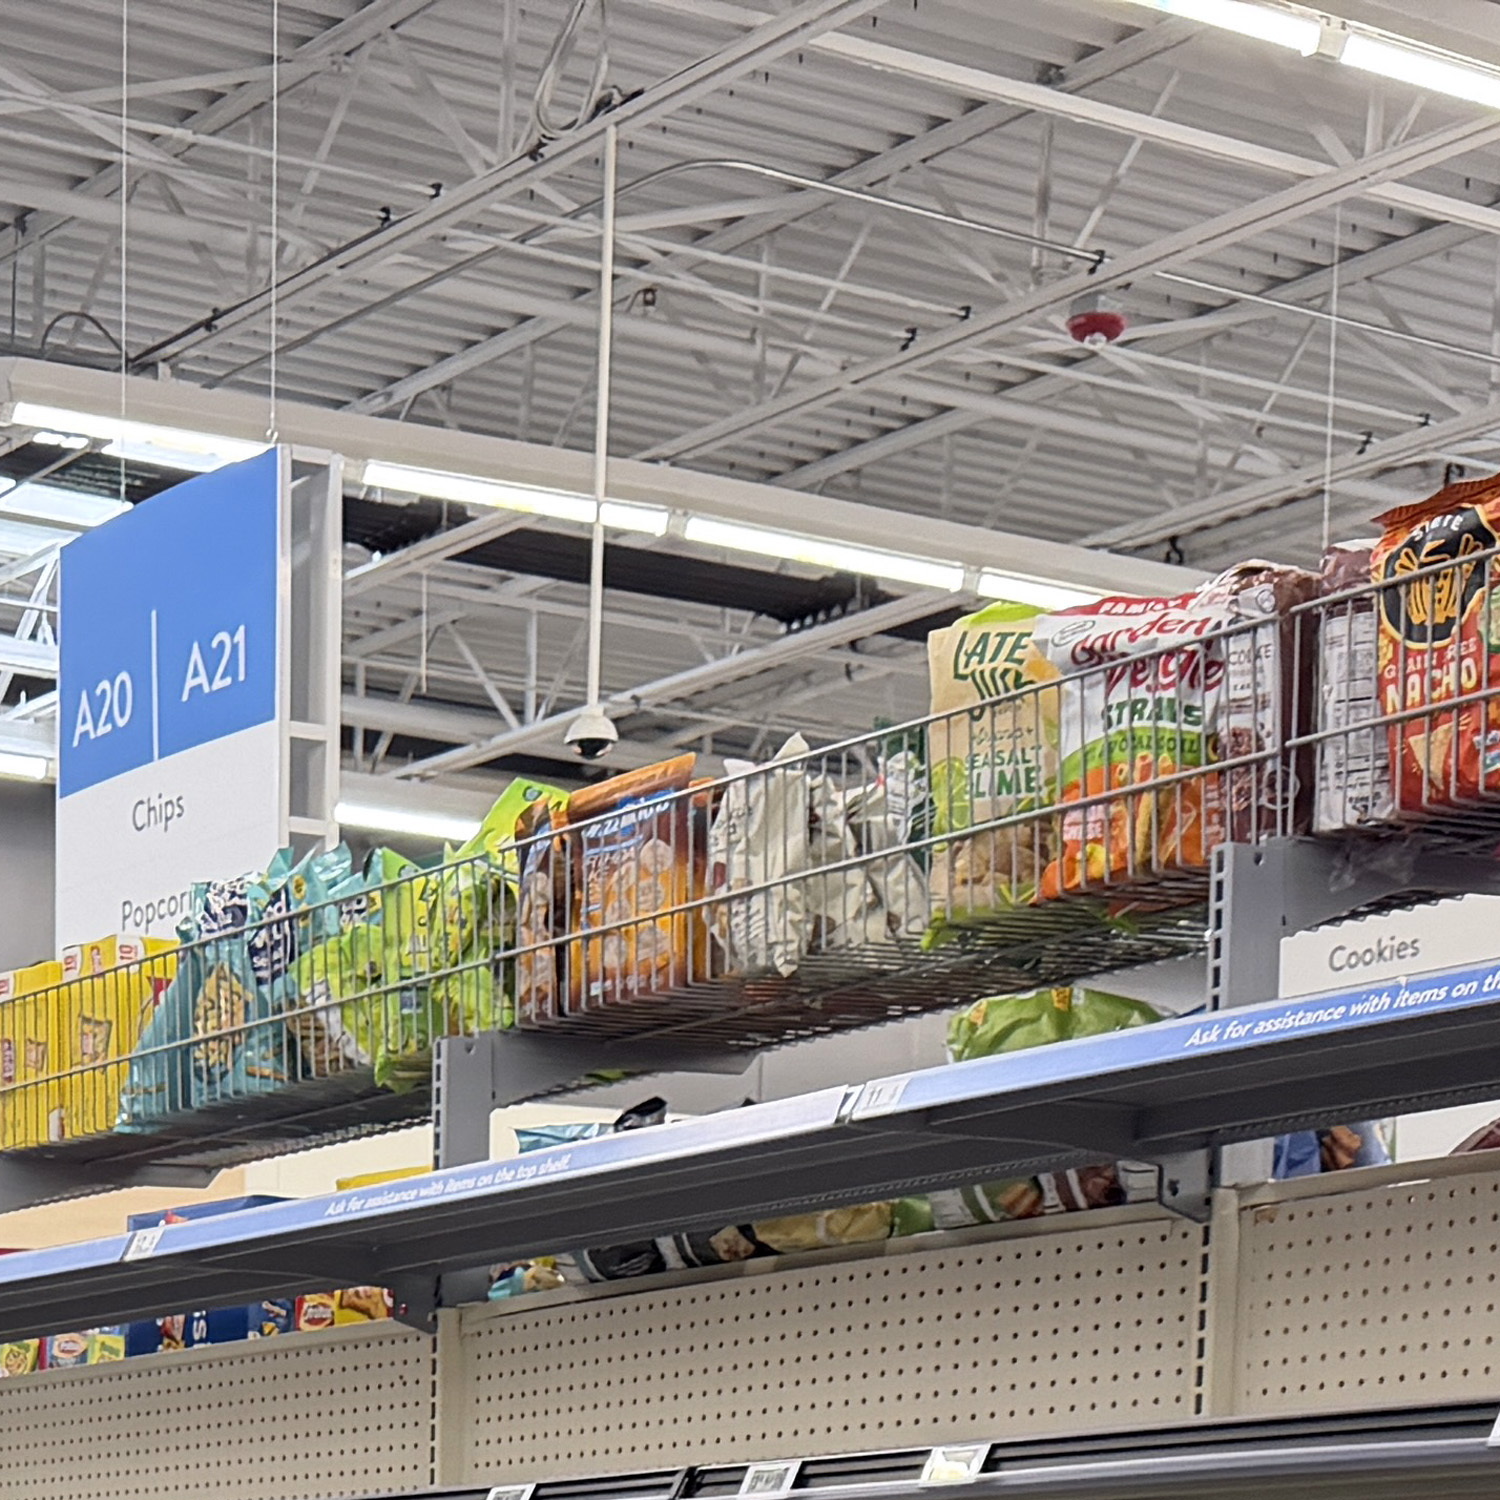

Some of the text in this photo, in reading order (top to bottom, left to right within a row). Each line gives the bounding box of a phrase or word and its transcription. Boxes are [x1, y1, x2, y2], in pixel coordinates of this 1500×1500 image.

[953, 630, 1034, 681] LATE
[72, 623, 247, 748] A20 A21
[1385, 656, 1478, 715] NACHO
[132, 792, 185, 834] Chips
[1328, 935, 1421, 973] Cookies
[1184, 1023, 1222, 1048] Ask
[1222, 1019, 1252, 1042] for
[1253, 1005, 1349, 1036] assistance
[1349, 991, 1392, 1018] with
[1393, 983, 1449, 1010] items
[1452, 979, 1479, 999] on
